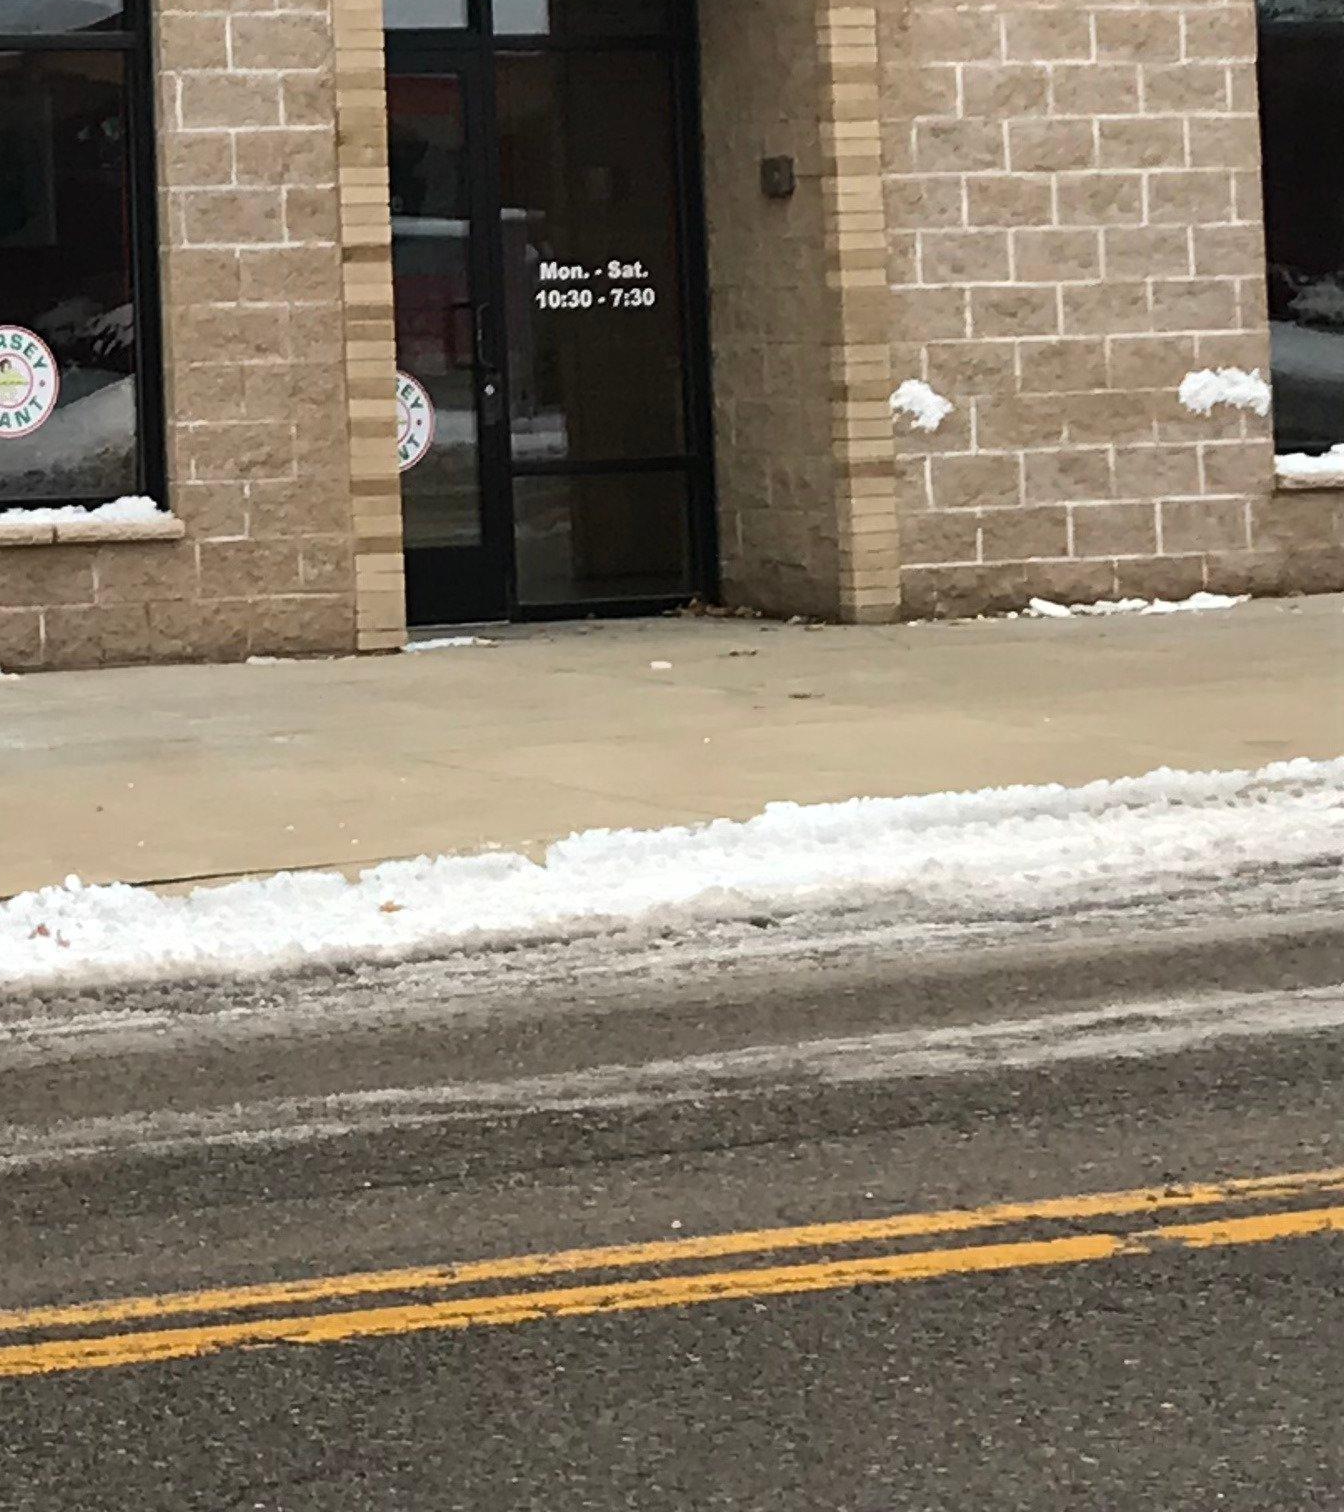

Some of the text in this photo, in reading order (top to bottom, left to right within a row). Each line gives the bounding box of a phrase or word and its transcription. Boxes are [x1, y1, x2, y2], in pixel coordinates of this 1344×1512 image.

[539, 262, 590, 280] Mon.
[607, 261, 649, 279] Sat.
[535, 289, 592, 308] 10:30
[611, 288, 656, 307] 7:30
